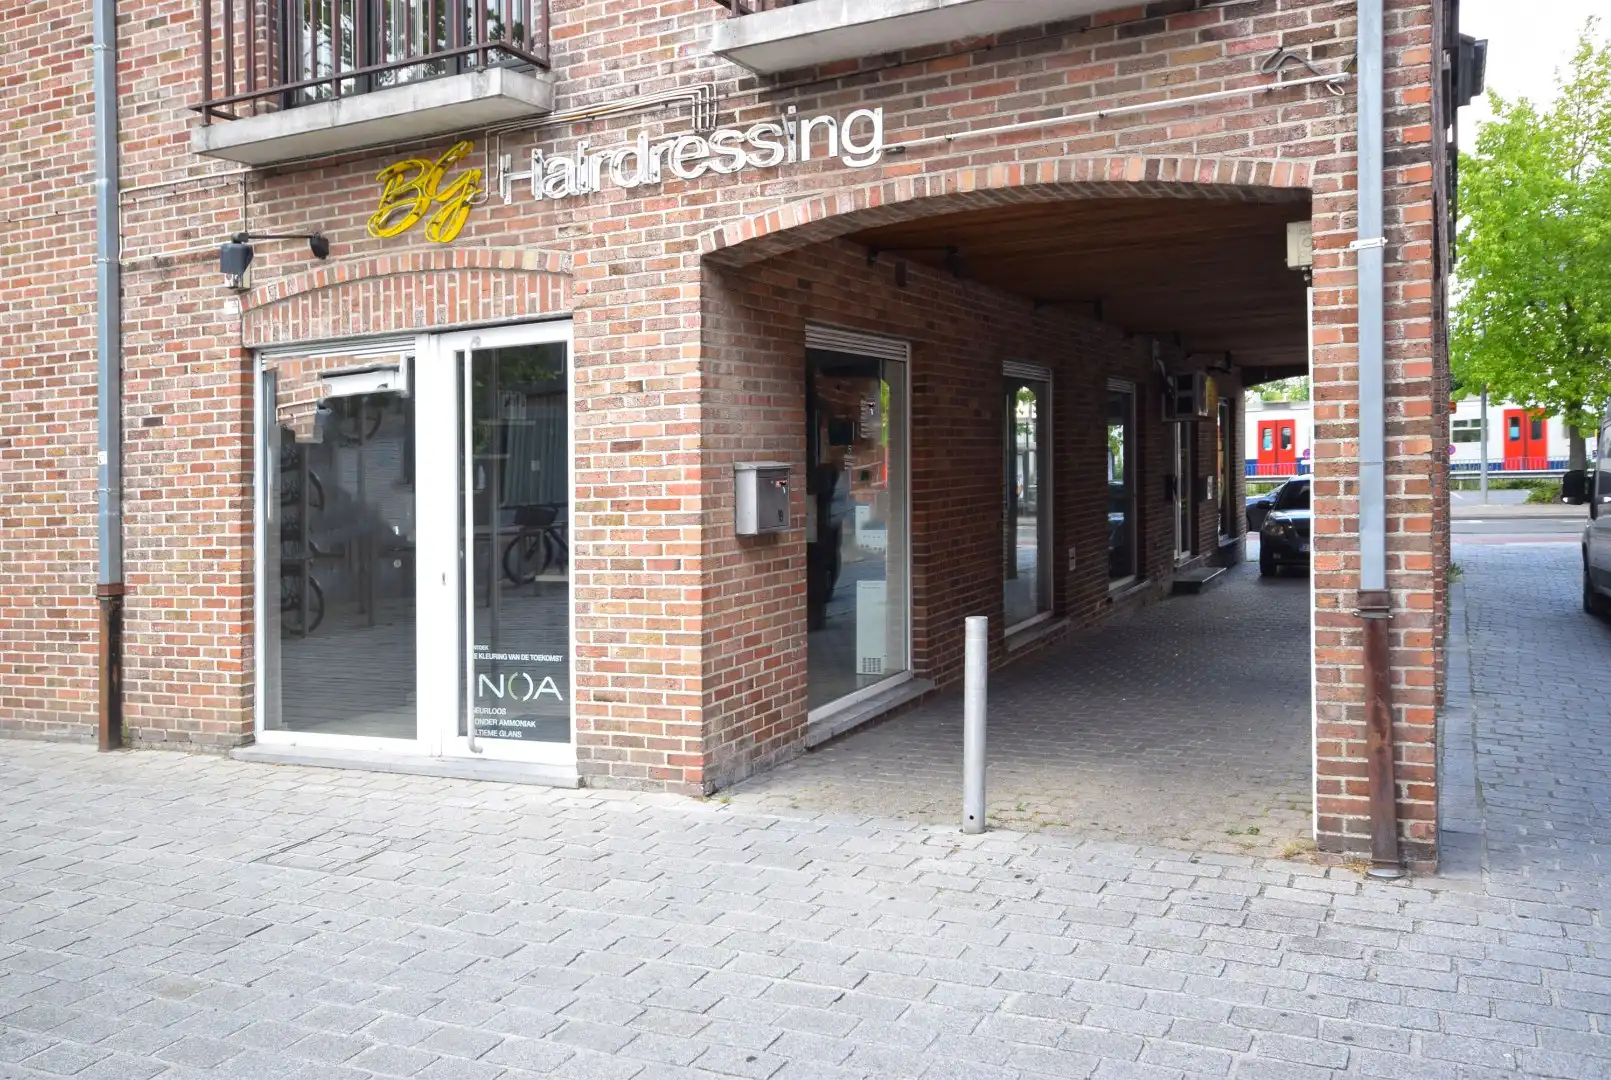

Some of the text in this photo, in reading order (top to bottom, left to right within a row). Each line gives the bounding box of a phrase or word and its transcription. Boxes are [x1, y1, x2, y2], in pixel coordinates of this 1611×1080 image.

[499, 105, 883, 204] Hairdressing
[530, 654, 563, 662] TOEKOMST
[478, 671, 564, 702] NOA
[474, 718, 536, 728] ONDER AMMONIAK
[474, 729, 522, 738] LTIEME GLANS
